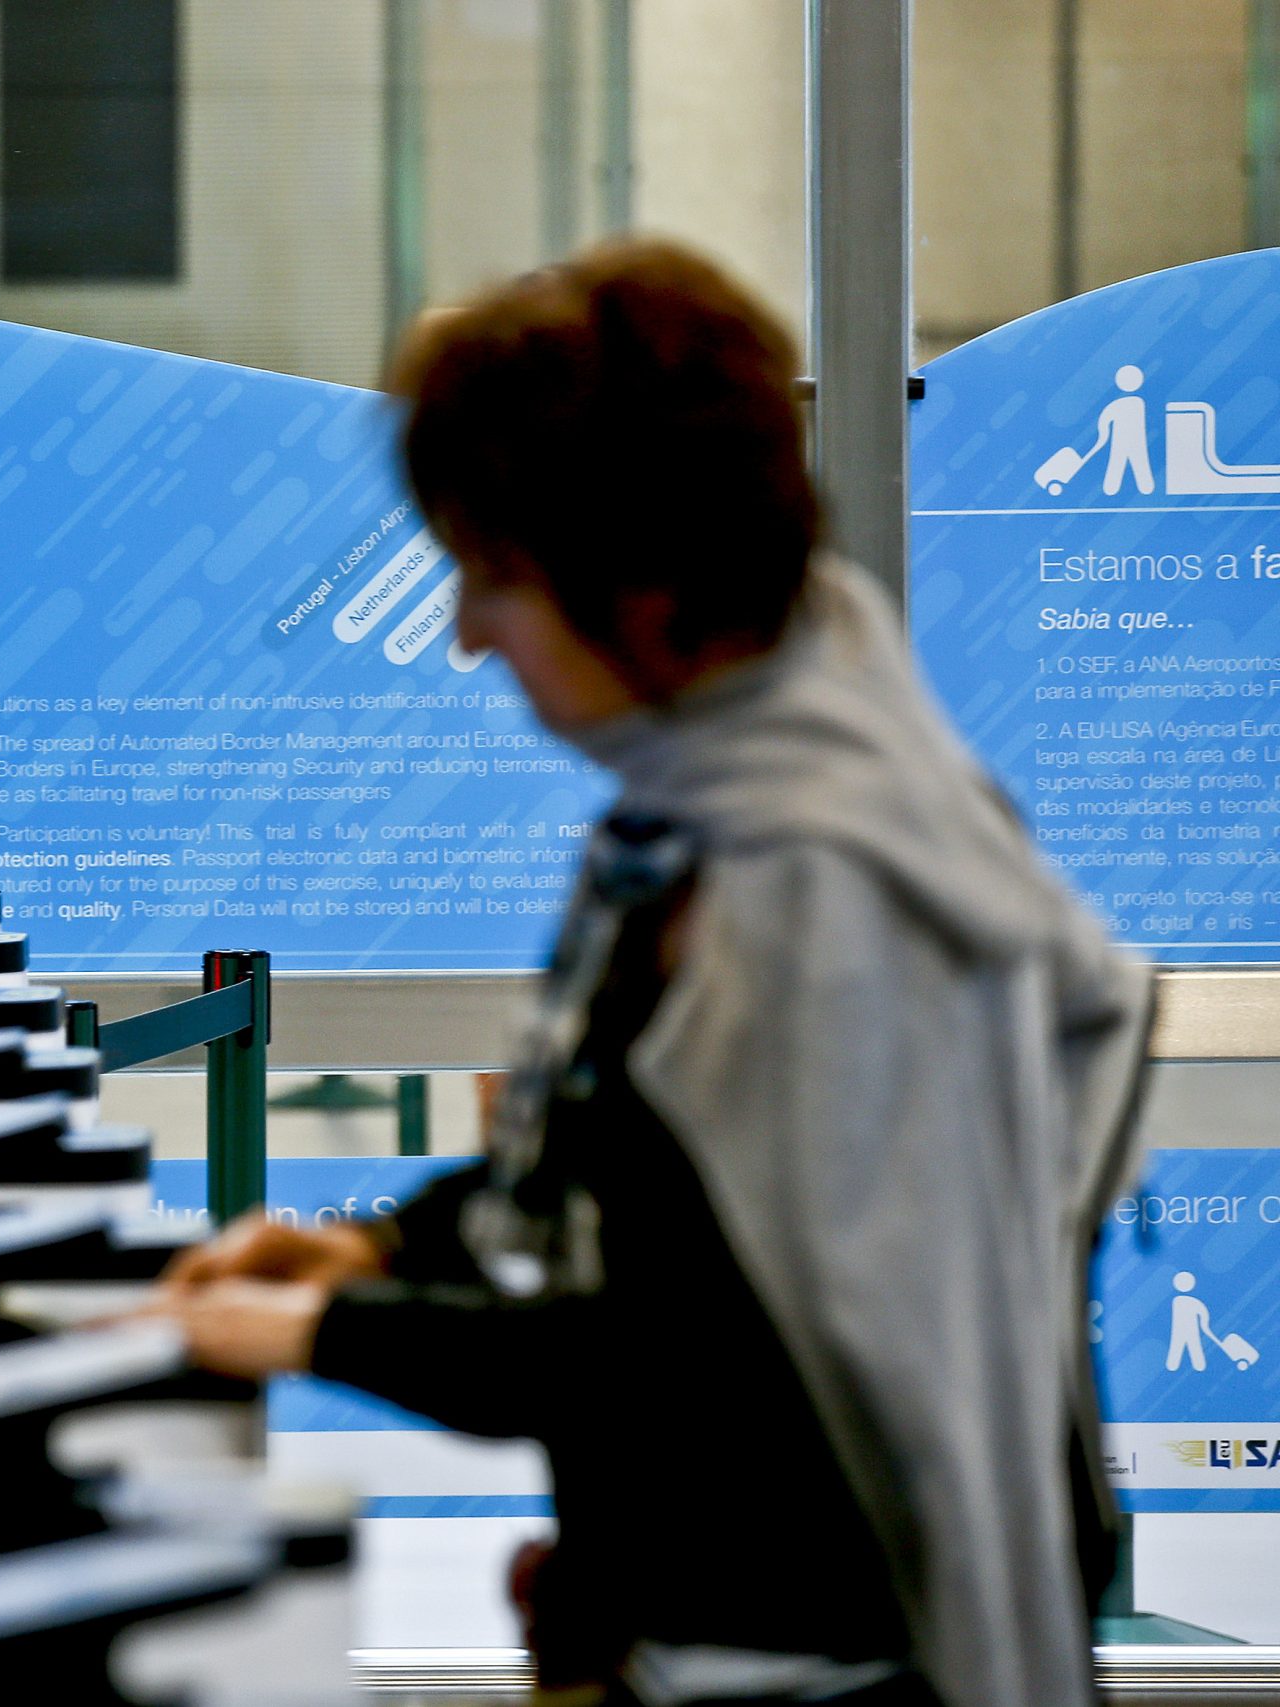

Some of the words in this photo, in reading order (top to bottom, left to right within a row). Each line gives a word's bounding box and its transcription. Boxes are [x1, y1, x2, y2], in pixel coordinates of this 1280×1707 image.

[1039, 547, 1203, 582] Estamos
[1215, 555, 1240, 580] a
[276, 578, 334, 634] Portugal
[337, 531, 381, 575] Lisbon
[348, 551, 424, 627] Netherlands
[395, 604, 445, 654] Finland
[1038, 607, 1111, 630] Sabia
[1118, 611, 1194, 634] que...
[1078, 657, 1118, 675] SEF,
[1138, 657, 1181, 672] ANA
[53, 698, 77, 711] as
[96, 694, 129, 715] key
[132, 693, 204, 711] element
[230, 692, 345, 710] non-intrusive
[348, 691, 459, 709] identification
[1035, 687, 1076, 702] para
[1097, 680, 1236, 702] implementação
[1239, 680, 1265, 696] de
[32, 734, 95, 755] spread
[119, 733, 218, 751] Automated
[220, 732, 281, 750] Border
[285, 731, 404, 753] Management
[406, 731, 470, 748] around
[473, 730, 539, 752] Europe
[1077, 722, 1154, 738] EU-LISA
[1158, 720, 1237, 741] (Agência
[91, 759, 161, 780] Europe,
[166, 758, 288, 780] strengthening
[292, 757, 365, 779] Security
[369, 757, 405, 774] and
[410, 757, 488, 778] reducing
[493, 756, 576, 776] terrorism,
[1035, 748, 1080, 767] larga
[1086, 747, 1146, 763] escala
[1153, 750, 1177, 762] na
[1183, 745, 1225, 761] área
[1232, 745, 1257, 761] de
[1035, 771, 1134, 792] supervisão
[1140, 772, 1192, 787] deste
[1198, 771, 1266, 791] projeto,
[13, 789, 37, 802] as
[40, 784, 127, 806] facilitating
[131, 784, 178, 801] travel
[183, 784, 207, 801] for
[210, 783, 283, 801] non-risk
[287, 786, 392, 804] passengers
[1035, 799, 1070, 814] das
[1076, 798, 1193, 814] modalidades
[126, 823, 211, 845] voluntary!
[217, 823, 254, 840] This
[265, 823, 296, 840] trial
[334, 822, 370, 844] fully
[379, 822, 467, 843] compliant
[478, 821, 516, 839] with
[1140, 824, 1166, 839] da
[1177, 823, 1262, 839] biometria
[74, 849, 176, 870] guidelines.
[182, 848, 262, 870] Passport
[266, 847, 353, 865] electronic
[358, 847, 398, 864] data
[403, 847, 438, 864] and
[443, 846, 525, 864] biometric
[1177, 852, 1212, 864] nas
[57, 875, 94, 896] only
[99, 875, 123, 892] for
[128, 874, 158, 892] the
[162, 878, 238, 895] purpose
[266, 873, 298, 891] this
[303, 873, 382, 892] exercise,
[389, 872, 463, 893] uniquely
[491, 871, 567, 889] evaluate
[18, 901, 54, 918] and
[57, 900, 125, 921] quality.
[131, 899, 210, 917] Personal
[213, 899, 257, 916] Data
[260, 898, 287, 916] will
[291, 898, 321, 915] not
[325, 898, 350, 915] be
[354, 897, 412, 915] stored
[414, 897, 451, 914] and
[454, 897, 482, 914] will
[486, 897, 510, 914] be
[1113, 889, 1177, 908] projeto
[1183, 888, 1255, 904] foca-se
[1141, 914, 1194, 934] digital
[1114, 1195, 1247, 1232] eparar
